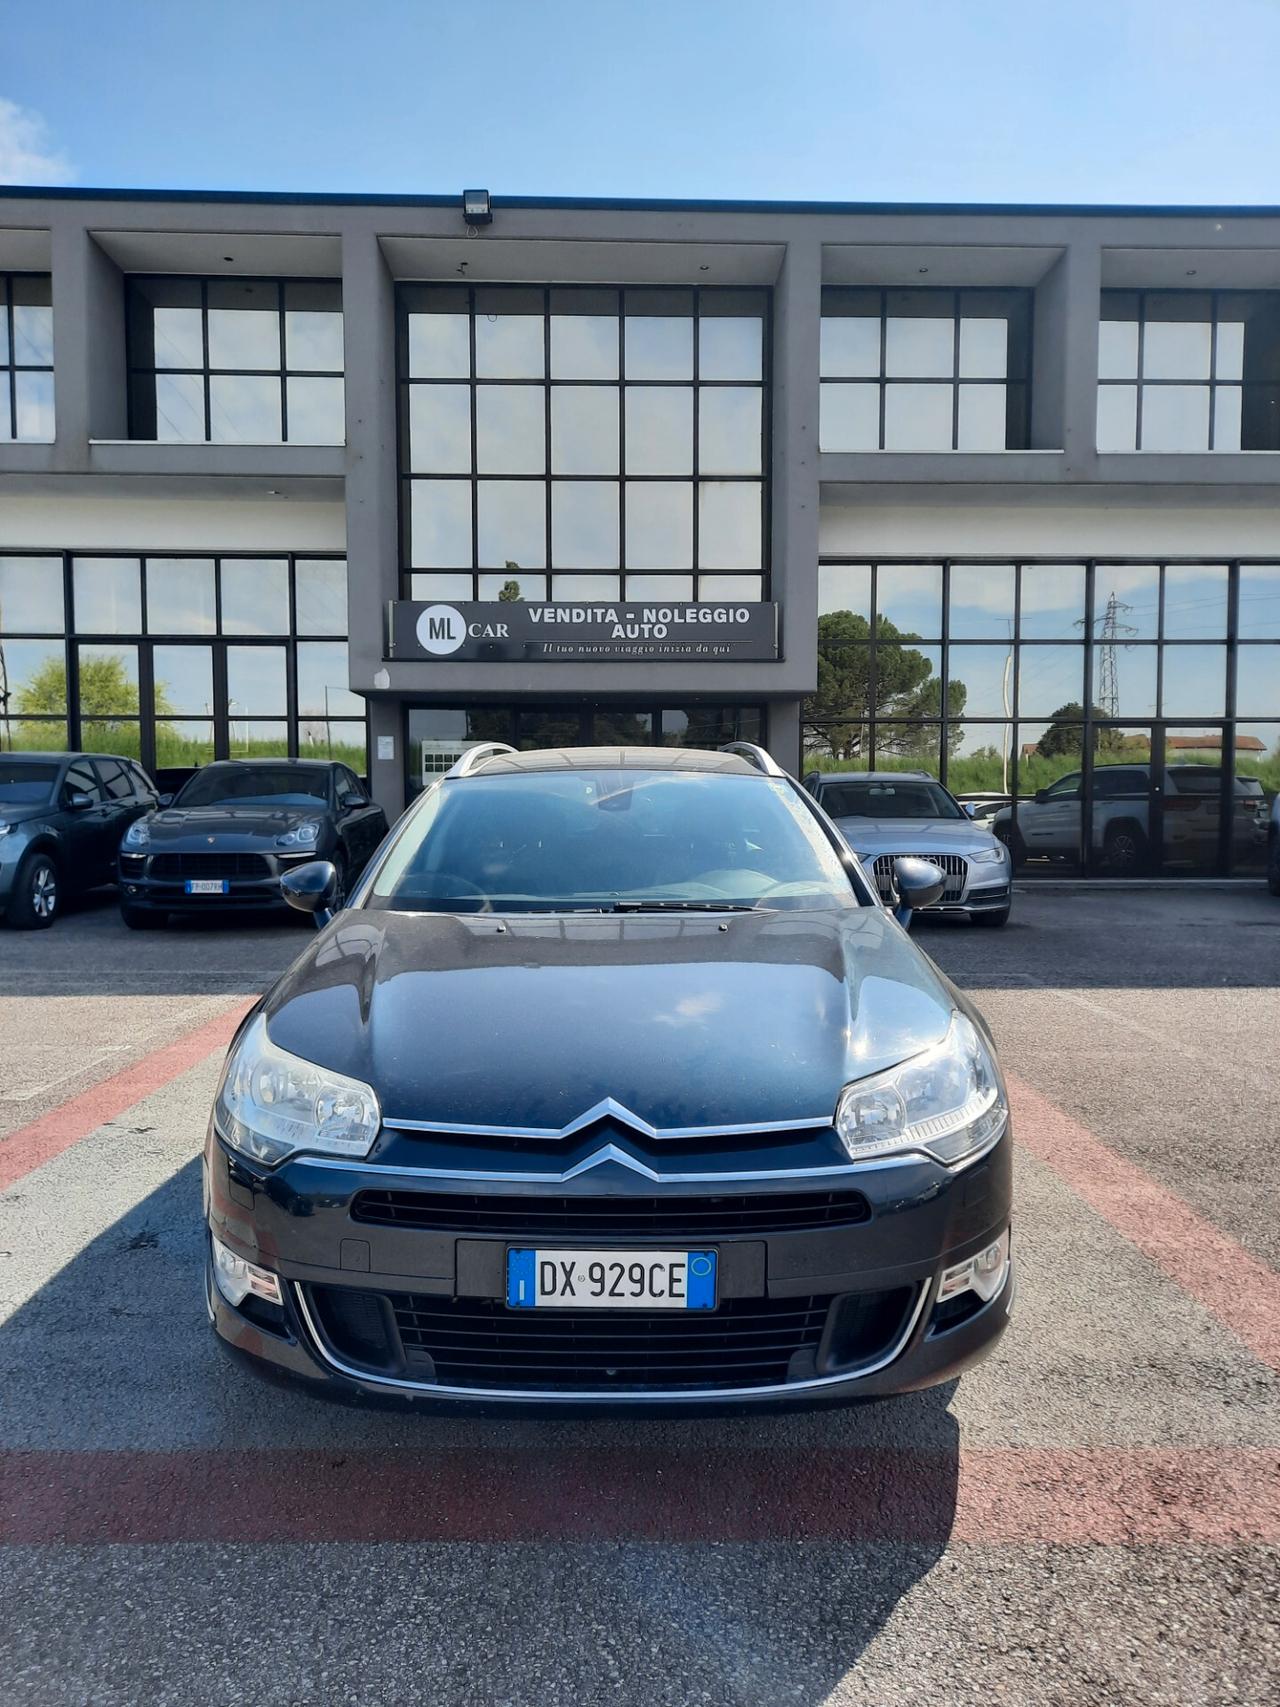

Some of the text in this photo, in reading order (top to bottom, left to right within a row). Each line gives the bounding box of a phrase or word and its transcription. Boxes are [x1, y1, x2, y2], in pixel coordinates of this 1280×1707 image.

[528, 607, 619, 623] VENDITA
[643, 607, 750, 623] NOLEGGIO
[429, 617, 509, 640] ML CAR
[611, 623, 668, 639] AUTO
[543, 643, 731, 655] Il tuo nuovo viaggio inizia da qui
[588, 1262, 686, 1298] 929CE
